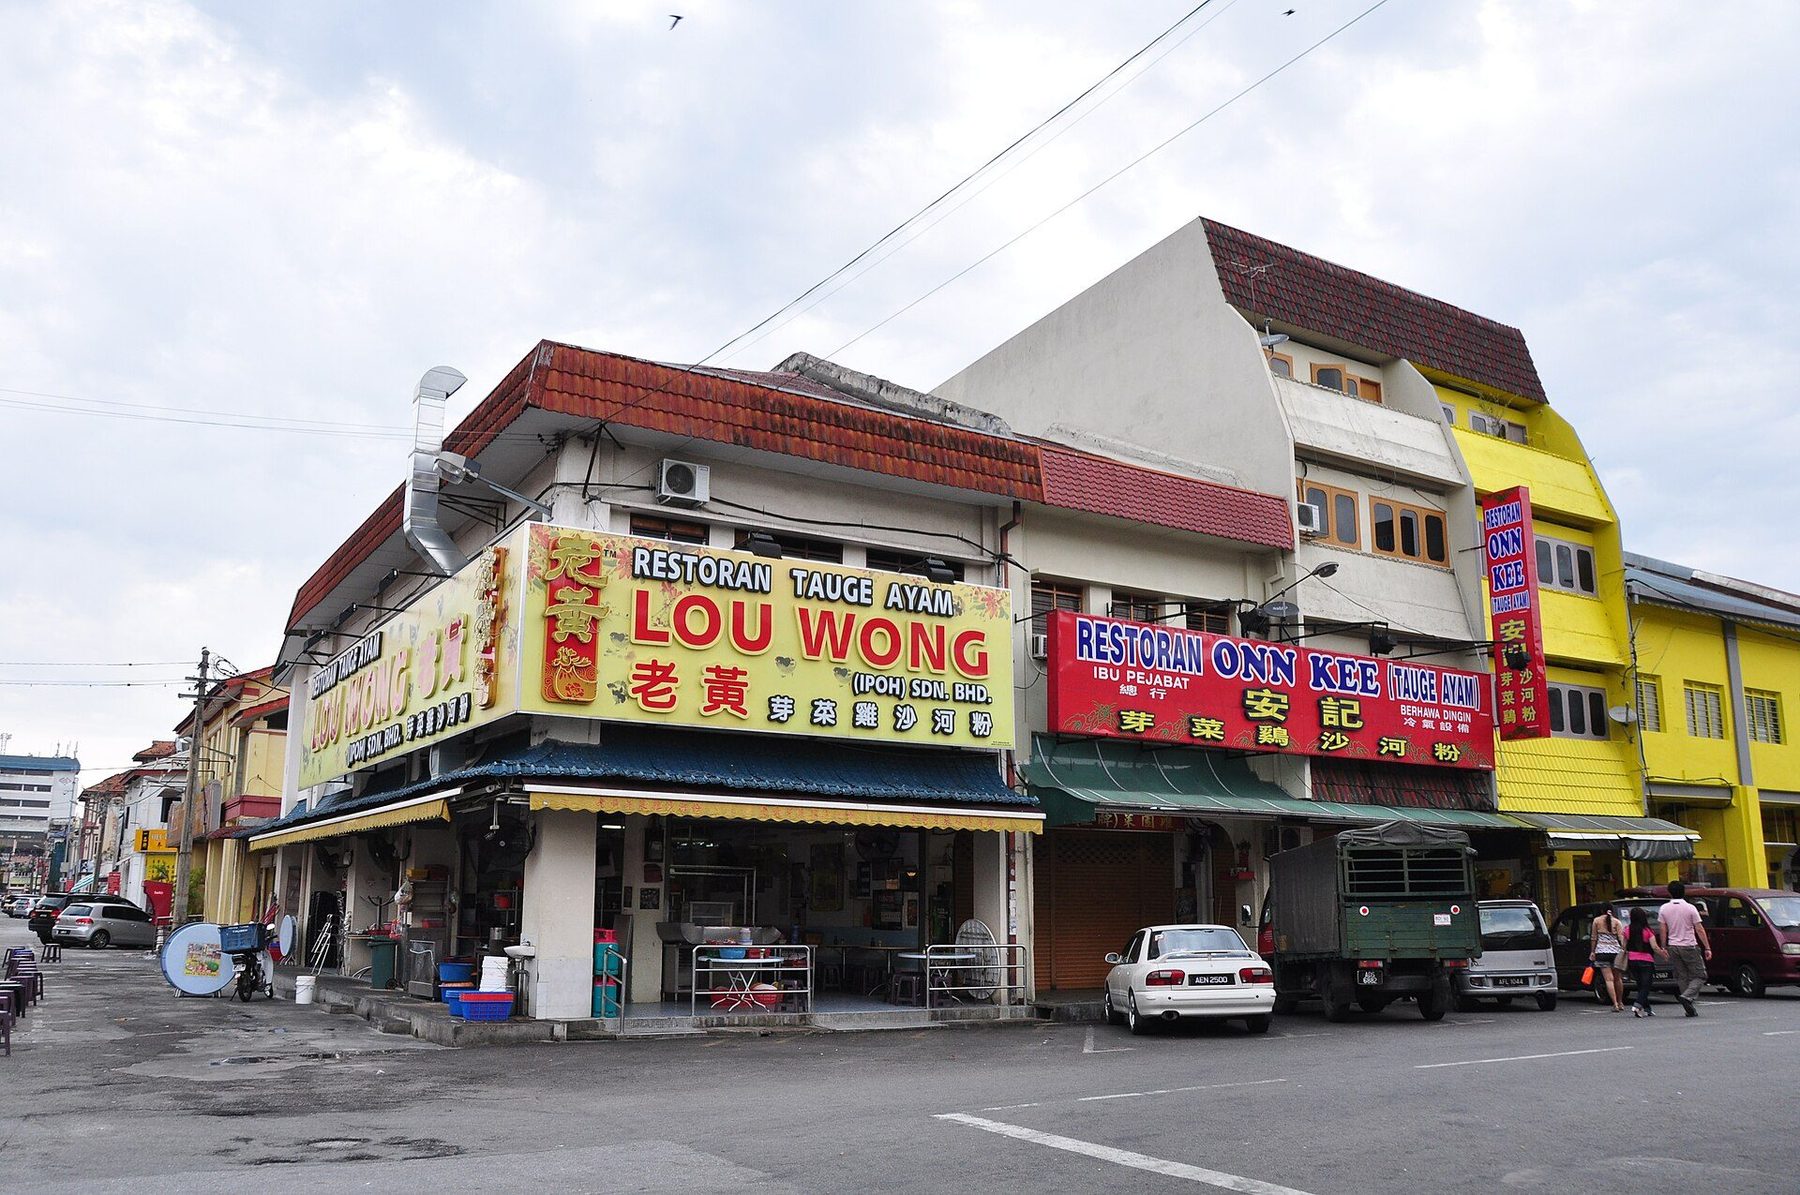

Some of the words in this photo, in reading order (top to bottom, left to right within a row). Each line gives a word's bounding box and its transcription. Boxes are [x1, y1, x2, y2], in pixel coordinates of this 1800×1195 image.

[1485, 501, 1521, 530] RESTORAN
[604, 549, 617, 558] TM
[1489, 527, 1523, 560] ONN
[633, 548, 771, 593] RESTORAN
[791, 569, 873, 605] TAUGE
[885, 584, 954, 617] AYAM
[1491, 560, 1525, 592] KEE
[633, 587, 772, 654] LOU
[795, 606, 990, 678] WONG
[1077, 618, 1203, 676] RESTORAN
[1212, 639, 1296, 687] ONN
[1308, 653, 1380, 698] KEE
[1387, 663, 1437, 704] (TAUGE
[1441, 672, 1480, 711] AYAM)
[1094, 666, 1120, 681] IBU
[1127, 670, 1190, 689] PEJABAT
[345, 648, 411, 737] WONG
[853, 672, 906, 699] (IPOH)
[910, 678, 950, 701] SDN.
[953, 683, 992, 703] BHD.
[1246, 688, 1364, 729] 安記
[1400, 705, 1440, 719] BERHAWA
[1443, 710, 1471, 722] DINGIN
[1195, 976, 1209, 984] AEN
[1210, 976, 1228, 984] 2500
